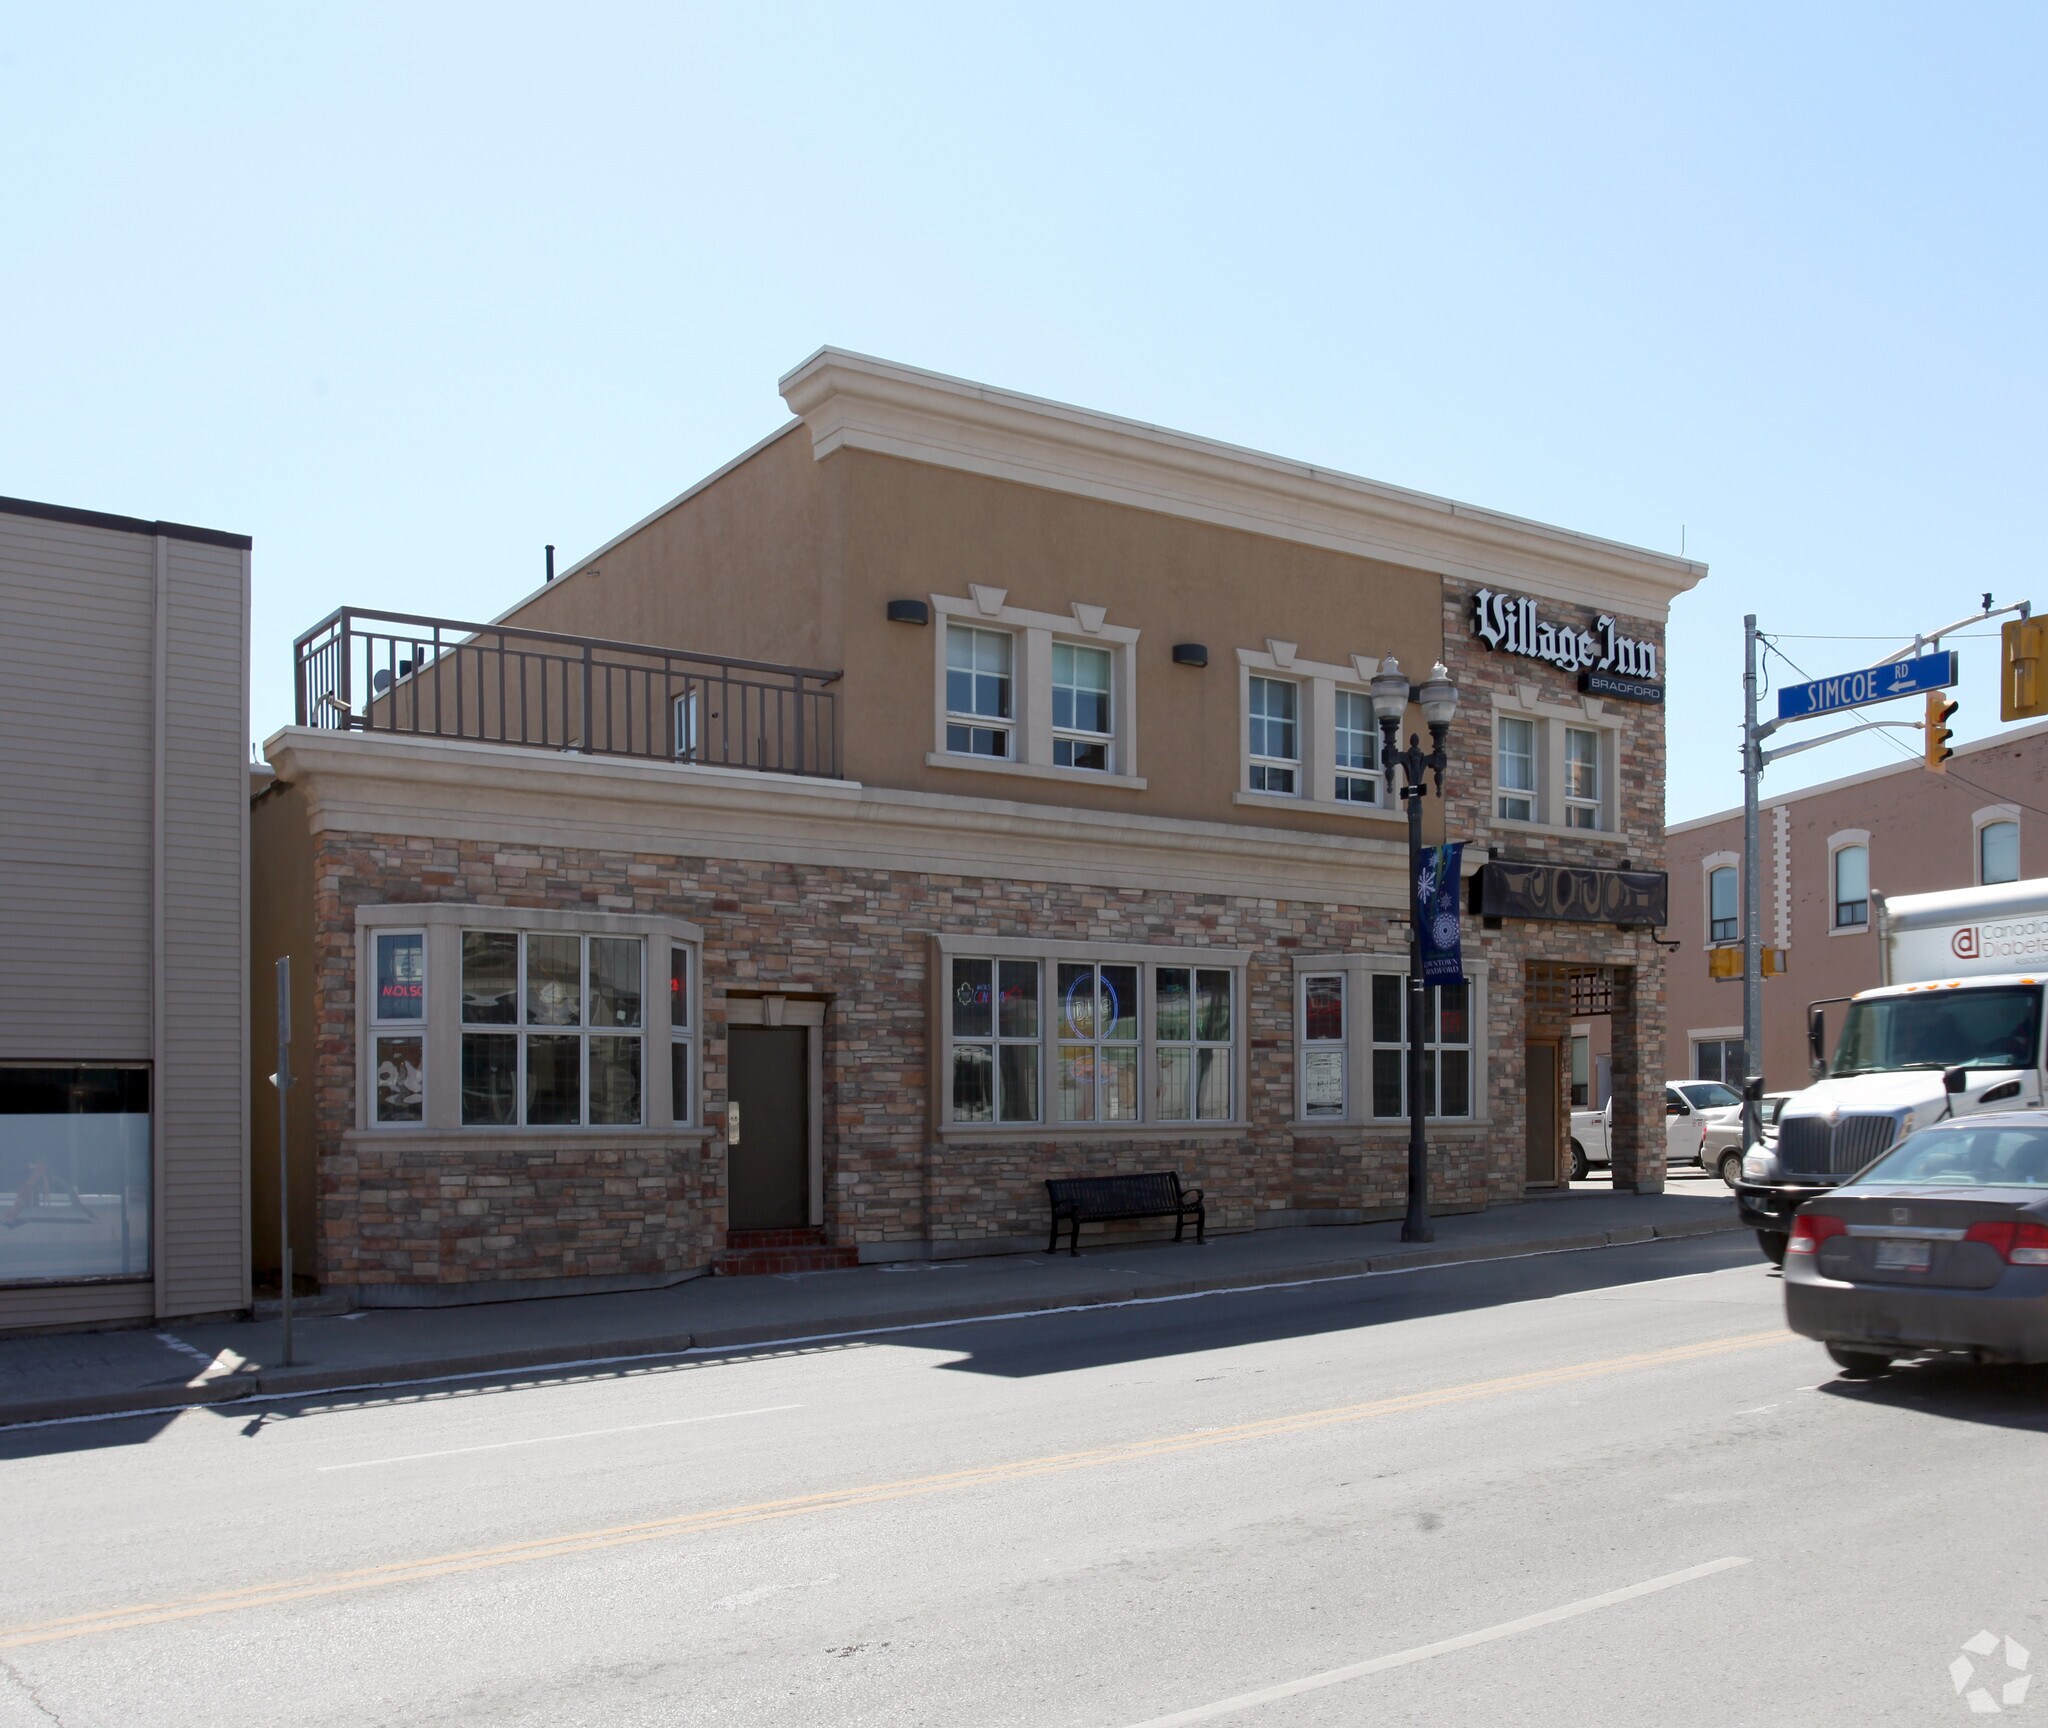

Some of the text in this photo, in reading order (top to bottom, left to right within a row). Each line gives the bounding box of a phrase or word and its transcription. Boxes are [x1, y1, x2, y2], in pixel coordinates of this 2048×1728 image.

[1475, 588, 1658, 679] Village Inn
[1591, 677, 1660, 699] BRADFORD
[1808, 664, 1909, 712] SIMCOE RD
[382, 985, 423, 997] MOLSO
